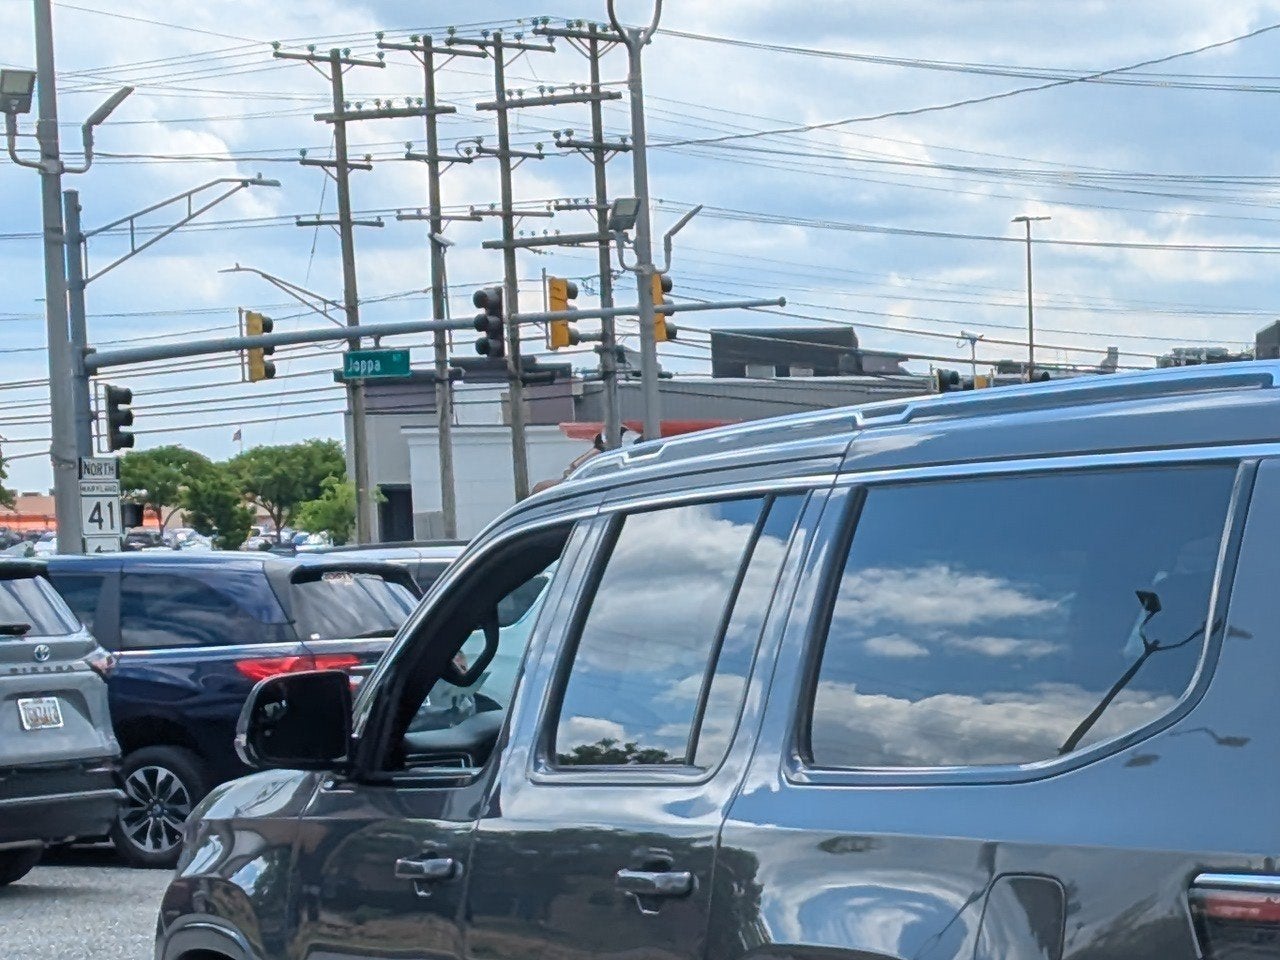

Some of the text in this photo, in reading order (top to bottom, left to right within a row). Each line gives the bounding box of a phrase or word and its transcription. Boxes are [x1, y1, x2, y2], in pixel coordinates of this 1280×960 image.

[348, 357, 381, 375] Joppa
[83, 462, 115, 476] NORTH
[88, 501, 115, 530] 41
